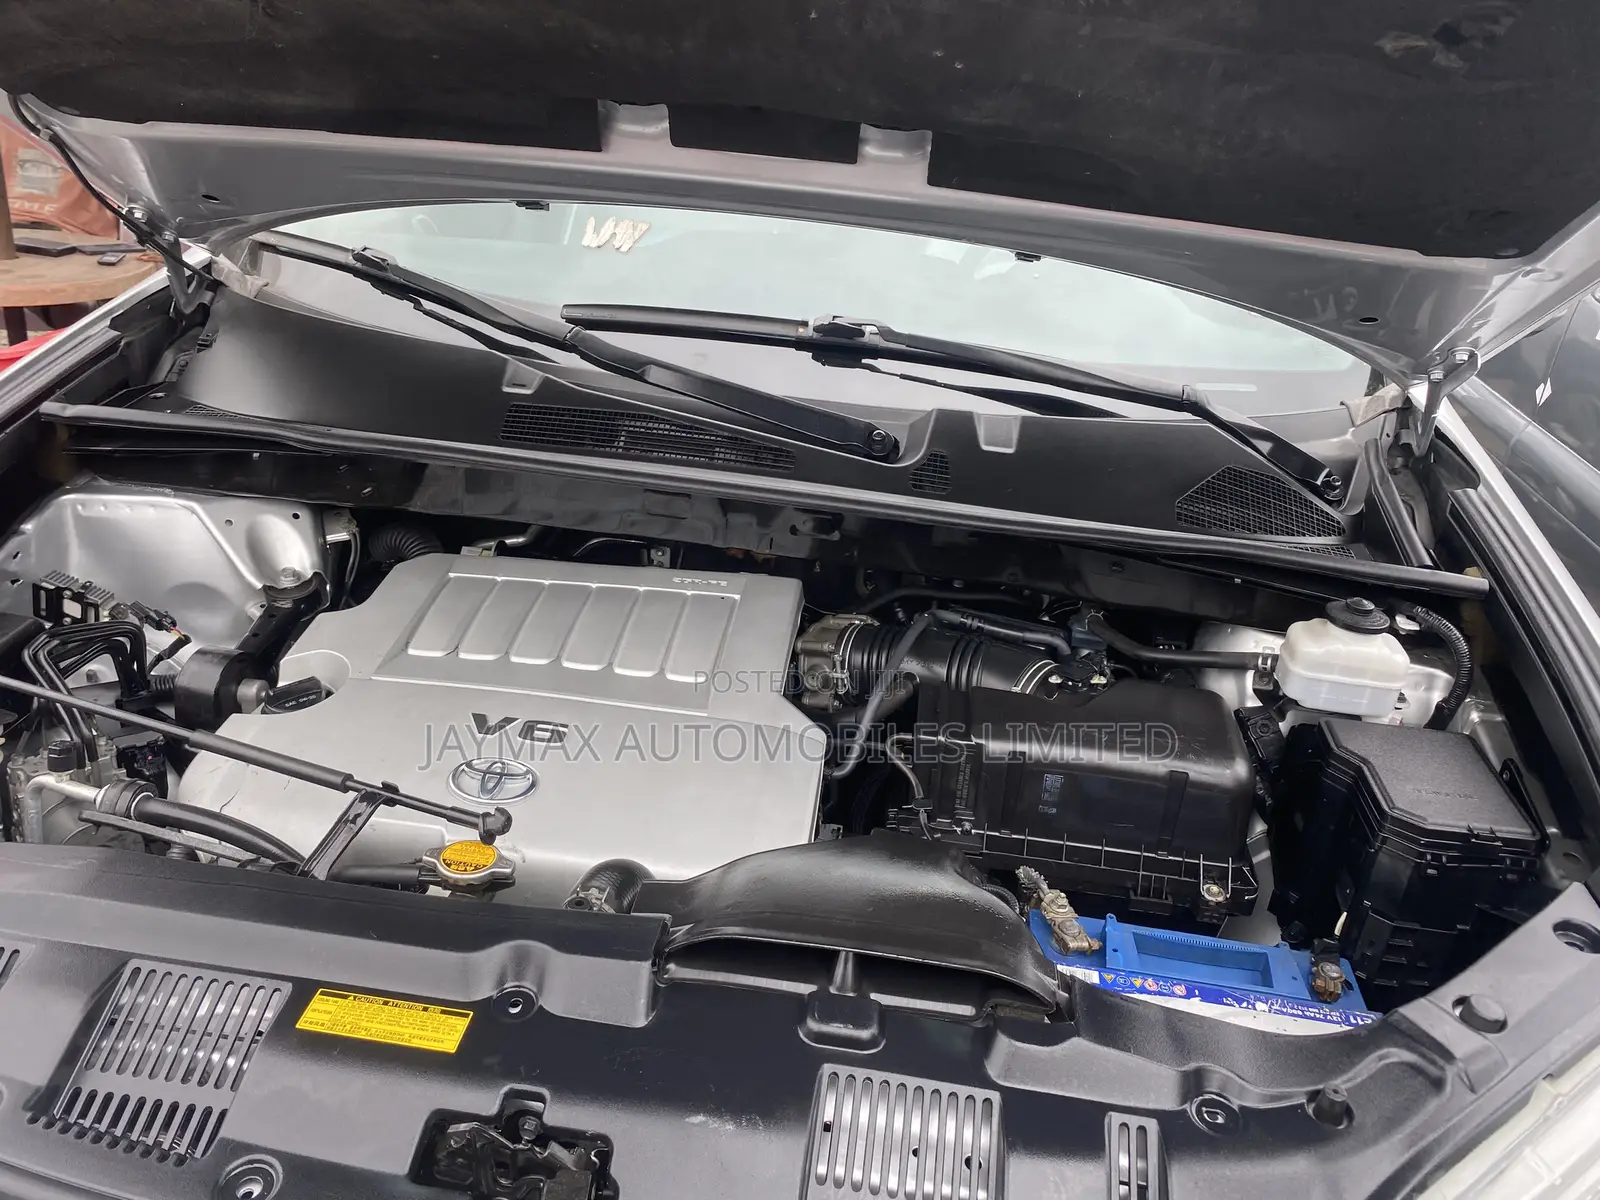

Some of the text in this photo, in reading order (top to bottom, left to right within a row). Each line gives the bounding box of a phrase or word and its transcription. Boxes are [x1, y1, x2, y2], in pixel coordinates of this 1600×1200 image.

[470, 712, 569, 744] V6
[445, 859, 483, 868] CAUTION
[355, 996, 384, 1006] CAUTION
[387, 1001, 424, 1011] ATTENTION
